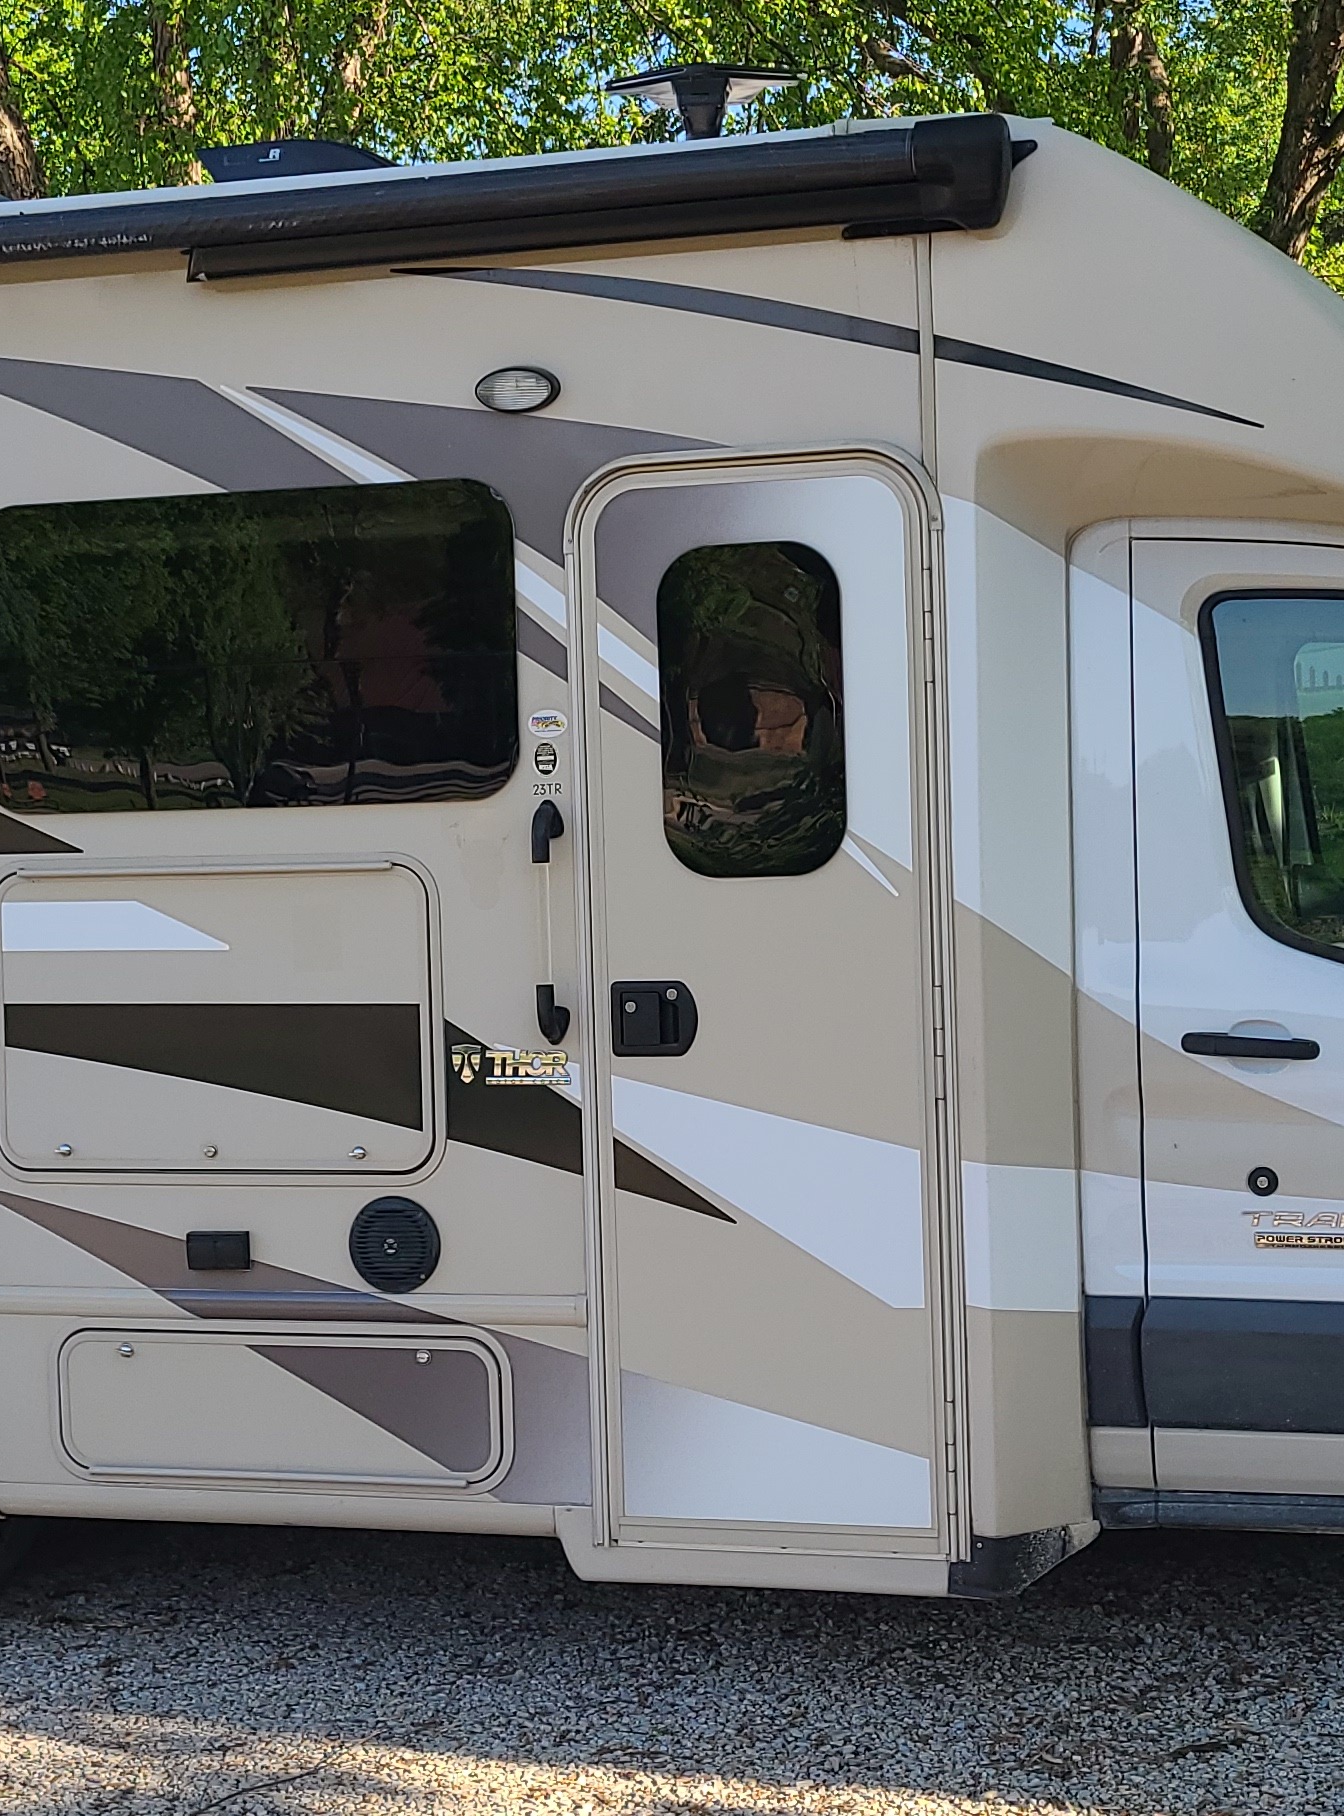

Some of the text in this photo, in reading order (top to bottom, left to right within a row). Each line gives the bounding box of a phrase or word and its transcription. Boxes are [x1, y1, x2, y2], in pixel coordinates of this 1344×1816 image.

[532, 783, 563, 796] 23TR
[485, 1050, 571, 1077] THOR
[1257, 1235, 1303, 1243] POWER
